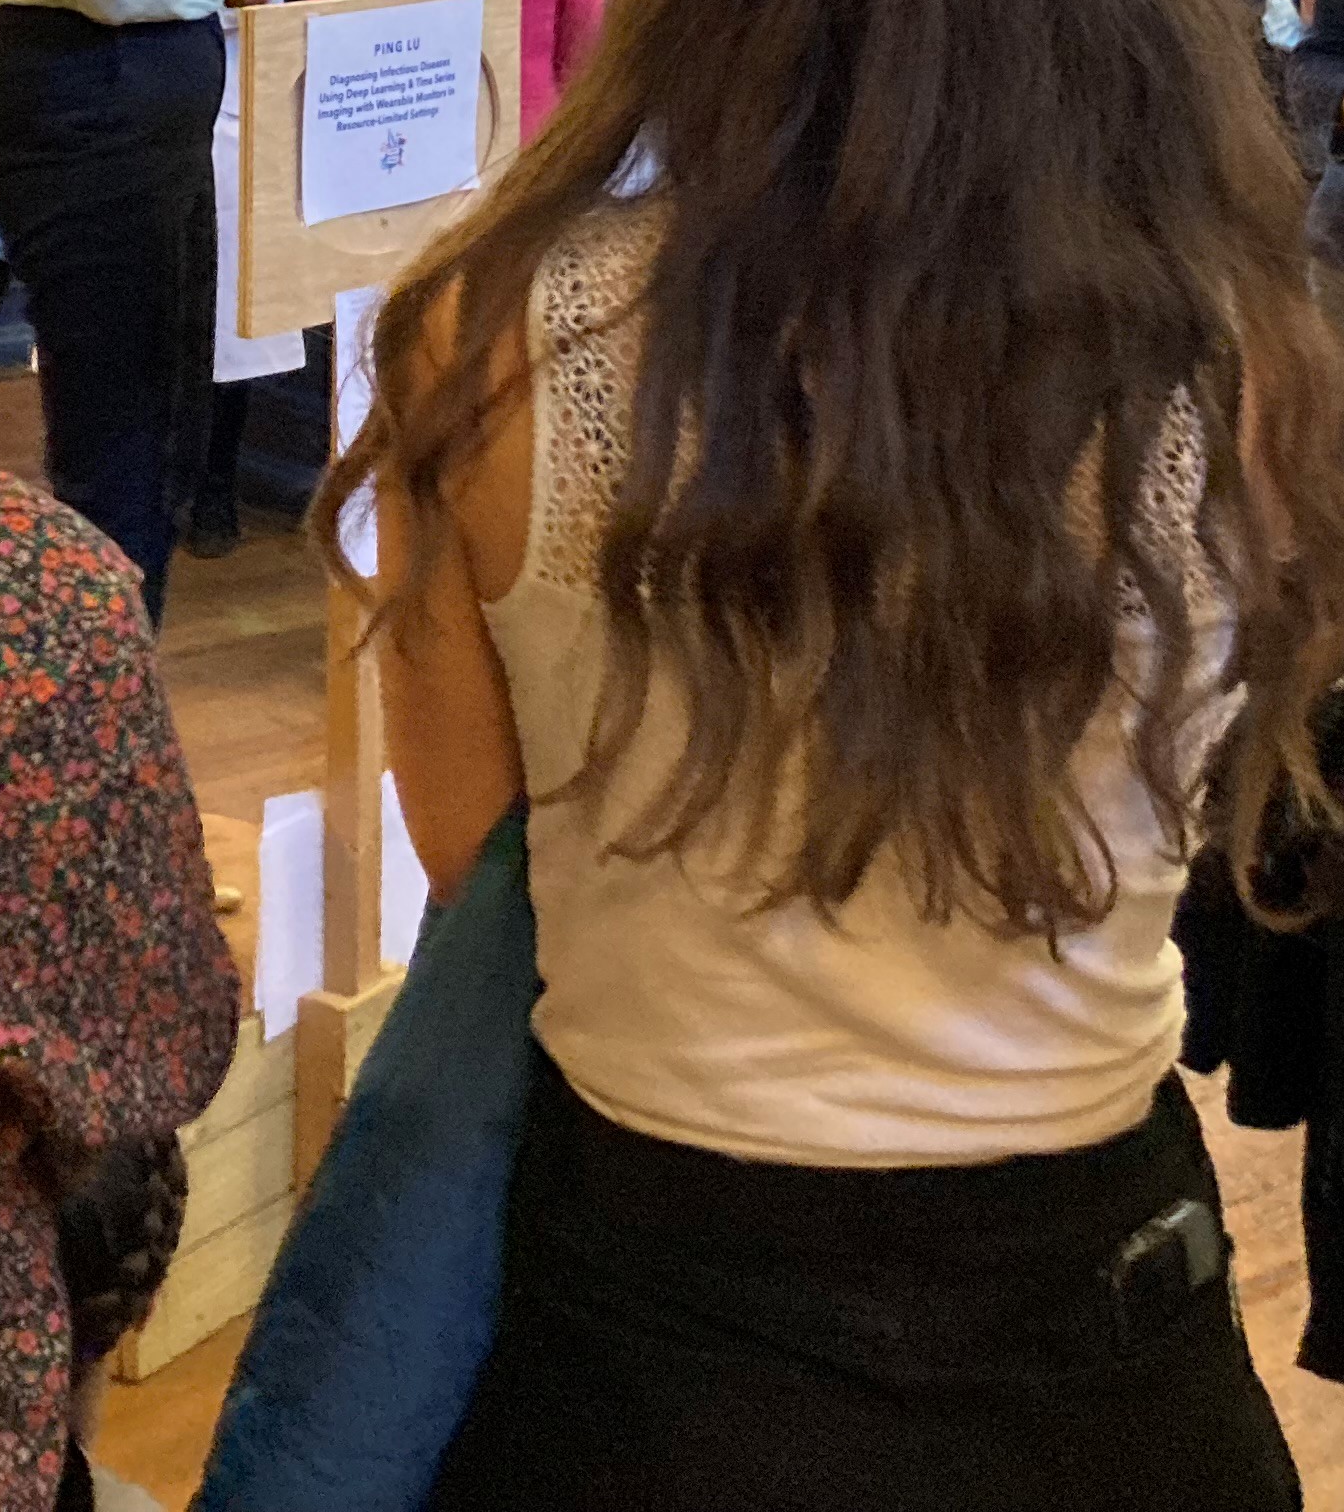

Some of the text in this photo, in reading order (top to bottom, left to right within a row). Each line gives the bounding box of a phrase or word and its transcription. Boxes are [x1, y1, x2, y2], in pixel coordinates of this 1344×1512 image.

[374, 37, 421, 56] PING LU
[319, 91, 345, 104] Using
[346, 88, 369, 100] Deep
[370, 82, 407, 95] Learning
[416, 76, 433, 88] Time
[434, 72, 456, 84] Series
[329, 71, 378, 87] Diagnosing
[317, 106, 354, 120] Imaging
[356, 100, 375, 113] with
[376, 95, 414, 109] Wearable
[336, 110, 409, 131] Resource-Limited
